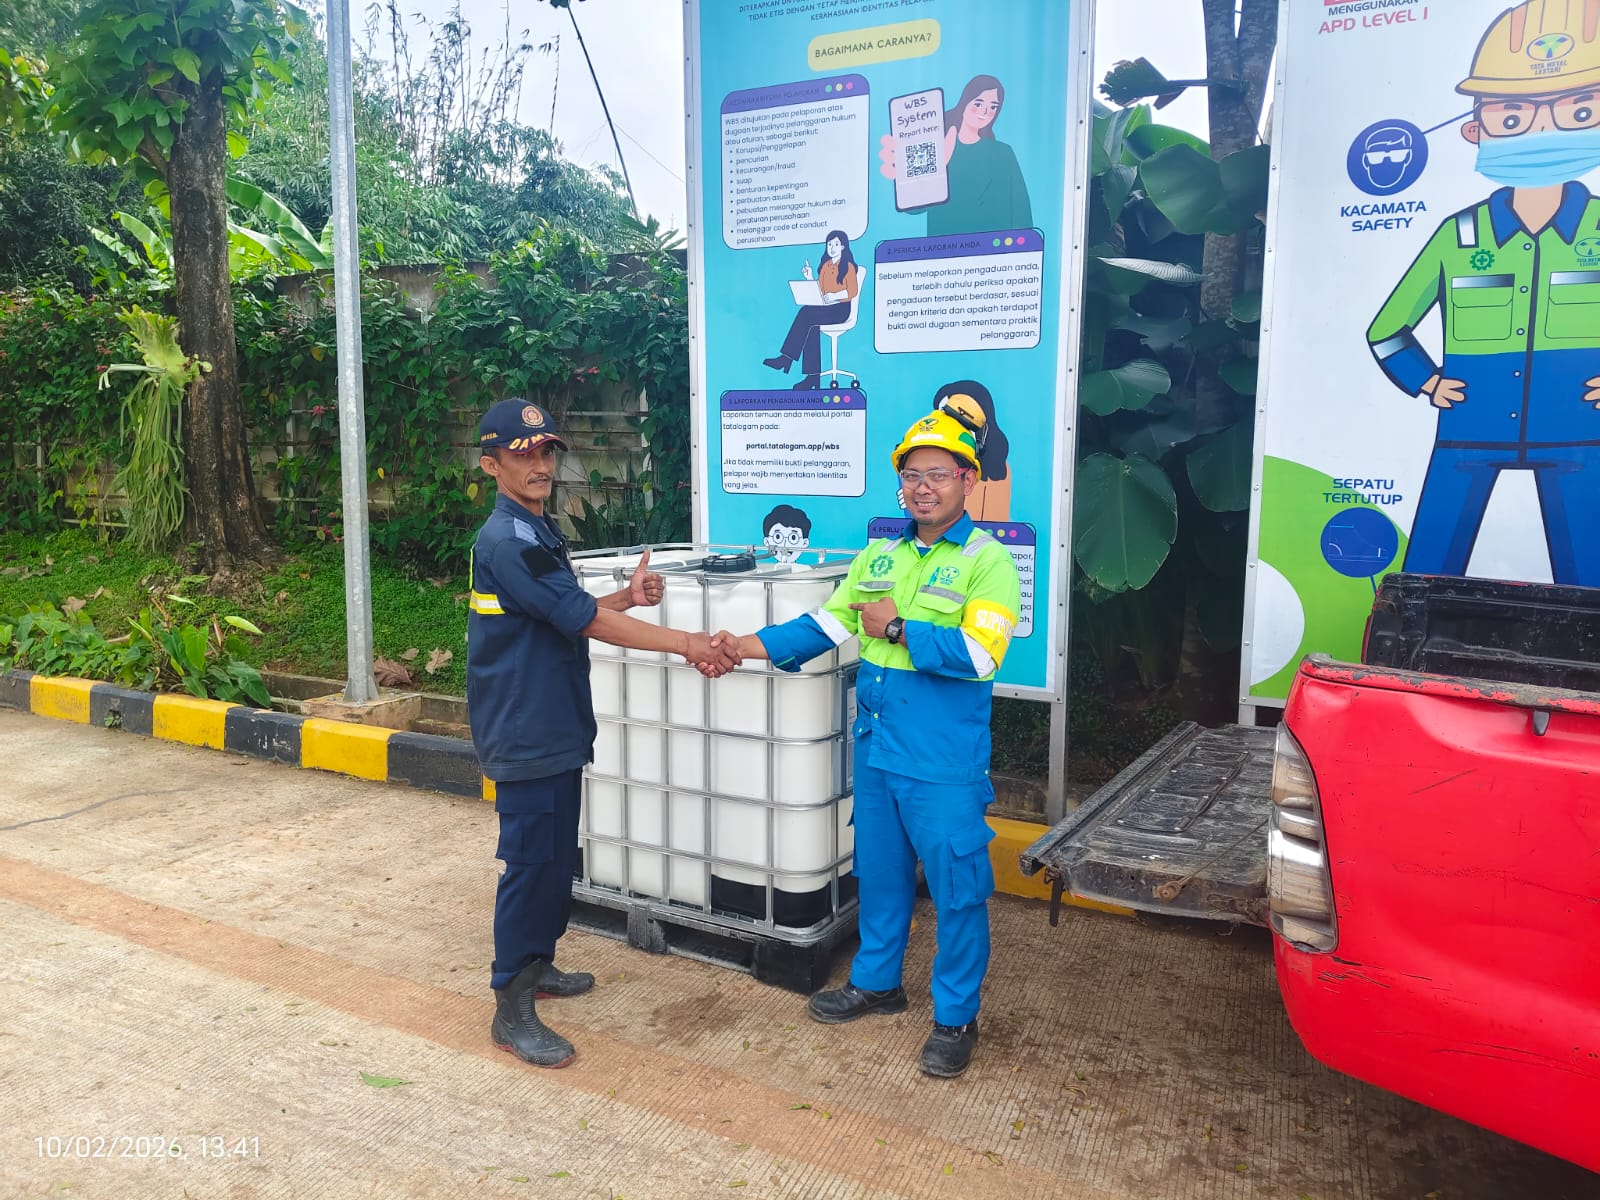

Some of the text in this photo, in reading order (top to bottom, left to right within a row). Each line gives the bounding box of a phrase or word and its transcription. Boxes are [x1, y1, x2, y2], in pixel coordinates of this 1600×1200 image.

[749, 12, 768, 21] TIDAK
[770, 9, 784, 17] ETIS
[786, 4, 814, 14] DENGAN
[811, 7, 859, 21] KERAHASIAAN
[862, 1, 898, 13] IDENTITAS
[1318, 18, 1356, 35] APD
[1362, 9, 1416, 28] LEVEL
[815, 32, 932, 58] BAGAIMANA CARANYA?
[904, 97, 927, 109] WBS
[740, 114, 770, 124] ditujukan
[772, 111, 789, 122] pada
[790, 106, 826, 120] pelaporan
[828, 104, 843, 112] atas
[897, 110, 936, 128] System
[725, 114, 856, 136] dugaan terjadinya pelanggaran hukum
[725, 138, 740, 146] atau
[766, 132, 793, 141] sebagai
[899, 129, 921, 139] Report
[736, 155, 769, 166] pencurian
[736, 162, 796, 175] kecurangan/fraud
[736, 178, 753, 187] suap
[736, 182, 809, 194] benturan kepentingan
[736, 196, 770, 206] perbuatan
[769, 202, 806, 211] melanggar
[807, 198, 830, 207] hukum
[1340, 200, 1427, 218] KACAMATA
[736, 212, 810, 225] peraturan perusahaan
[1351, 217, 1413, 232] SAFETY
[737, 226, 772, 234] melanggar
[800, 220, 827, 229] conduct
[737, 236, 775, 245] perusahaan
[923, 243, 957, 252] LAPORAN
[878, 263, 1040, 280] Sebelum melaporkan pengaduan anda,
[912, 276, 1039, 291] terlebih dahulu periksa apakah
[887, 289, 1039, 307] pengaduan tersebut berdasar, sesuai
[888, 302, 1038, 319] dengan kriteria dan apakah terdapat
[888, 316, 1038, 330] bukti awal dugaan sementara praktik
[980, 329, 1038, 342] pelanggaran.
[722, 411, 754, 419] Laporkan
[831, 411, 852, 420] portal
[760, 423, 780, 431] pada:
[746, 442, 840, 452] portal.tatalogam.app/wbs
[803, 460, 851, 468] pelanggaran,
[1333, 478, 1394, 490] SEPATU
[1322, 492, 1403, 505] TERTUTUP
